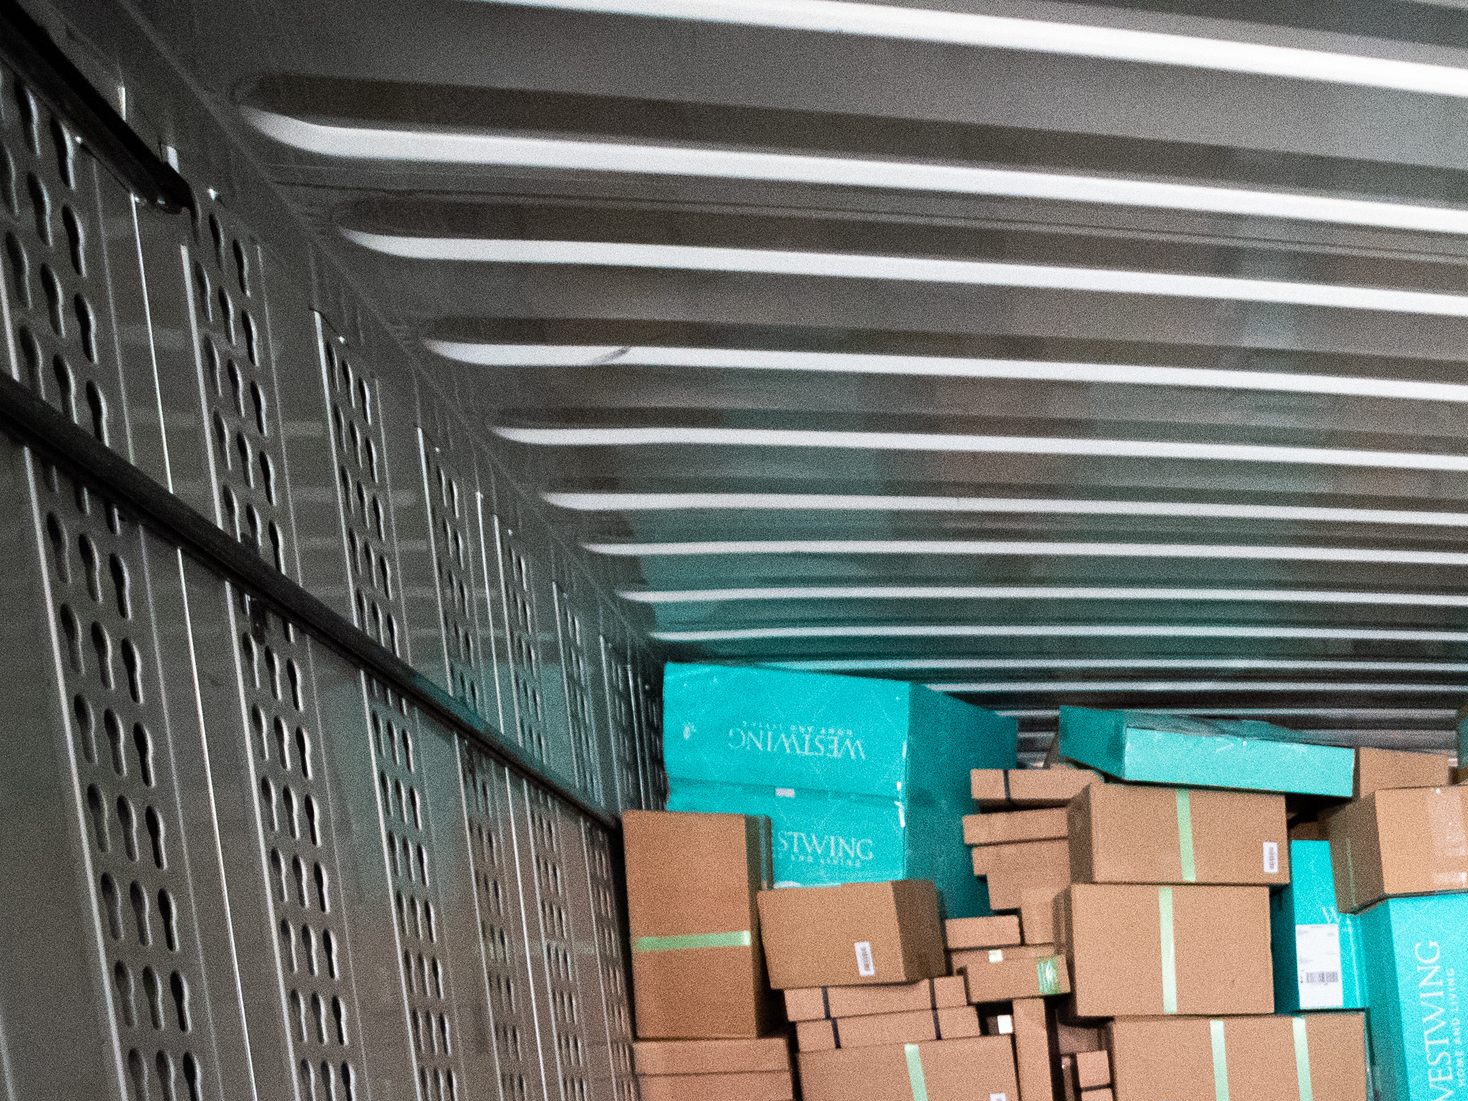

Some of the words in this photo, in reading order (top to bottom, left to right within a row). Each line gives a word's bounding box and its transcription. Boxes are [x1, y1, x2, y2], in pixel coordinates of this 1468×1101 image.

[728, 727, 867, 761] WESTWING
[1446, 968, 1460, 1012] LIVING
[1452, 1018, 1463, 1047] AND
[1454, 1051, 1466, 1088] HOME
